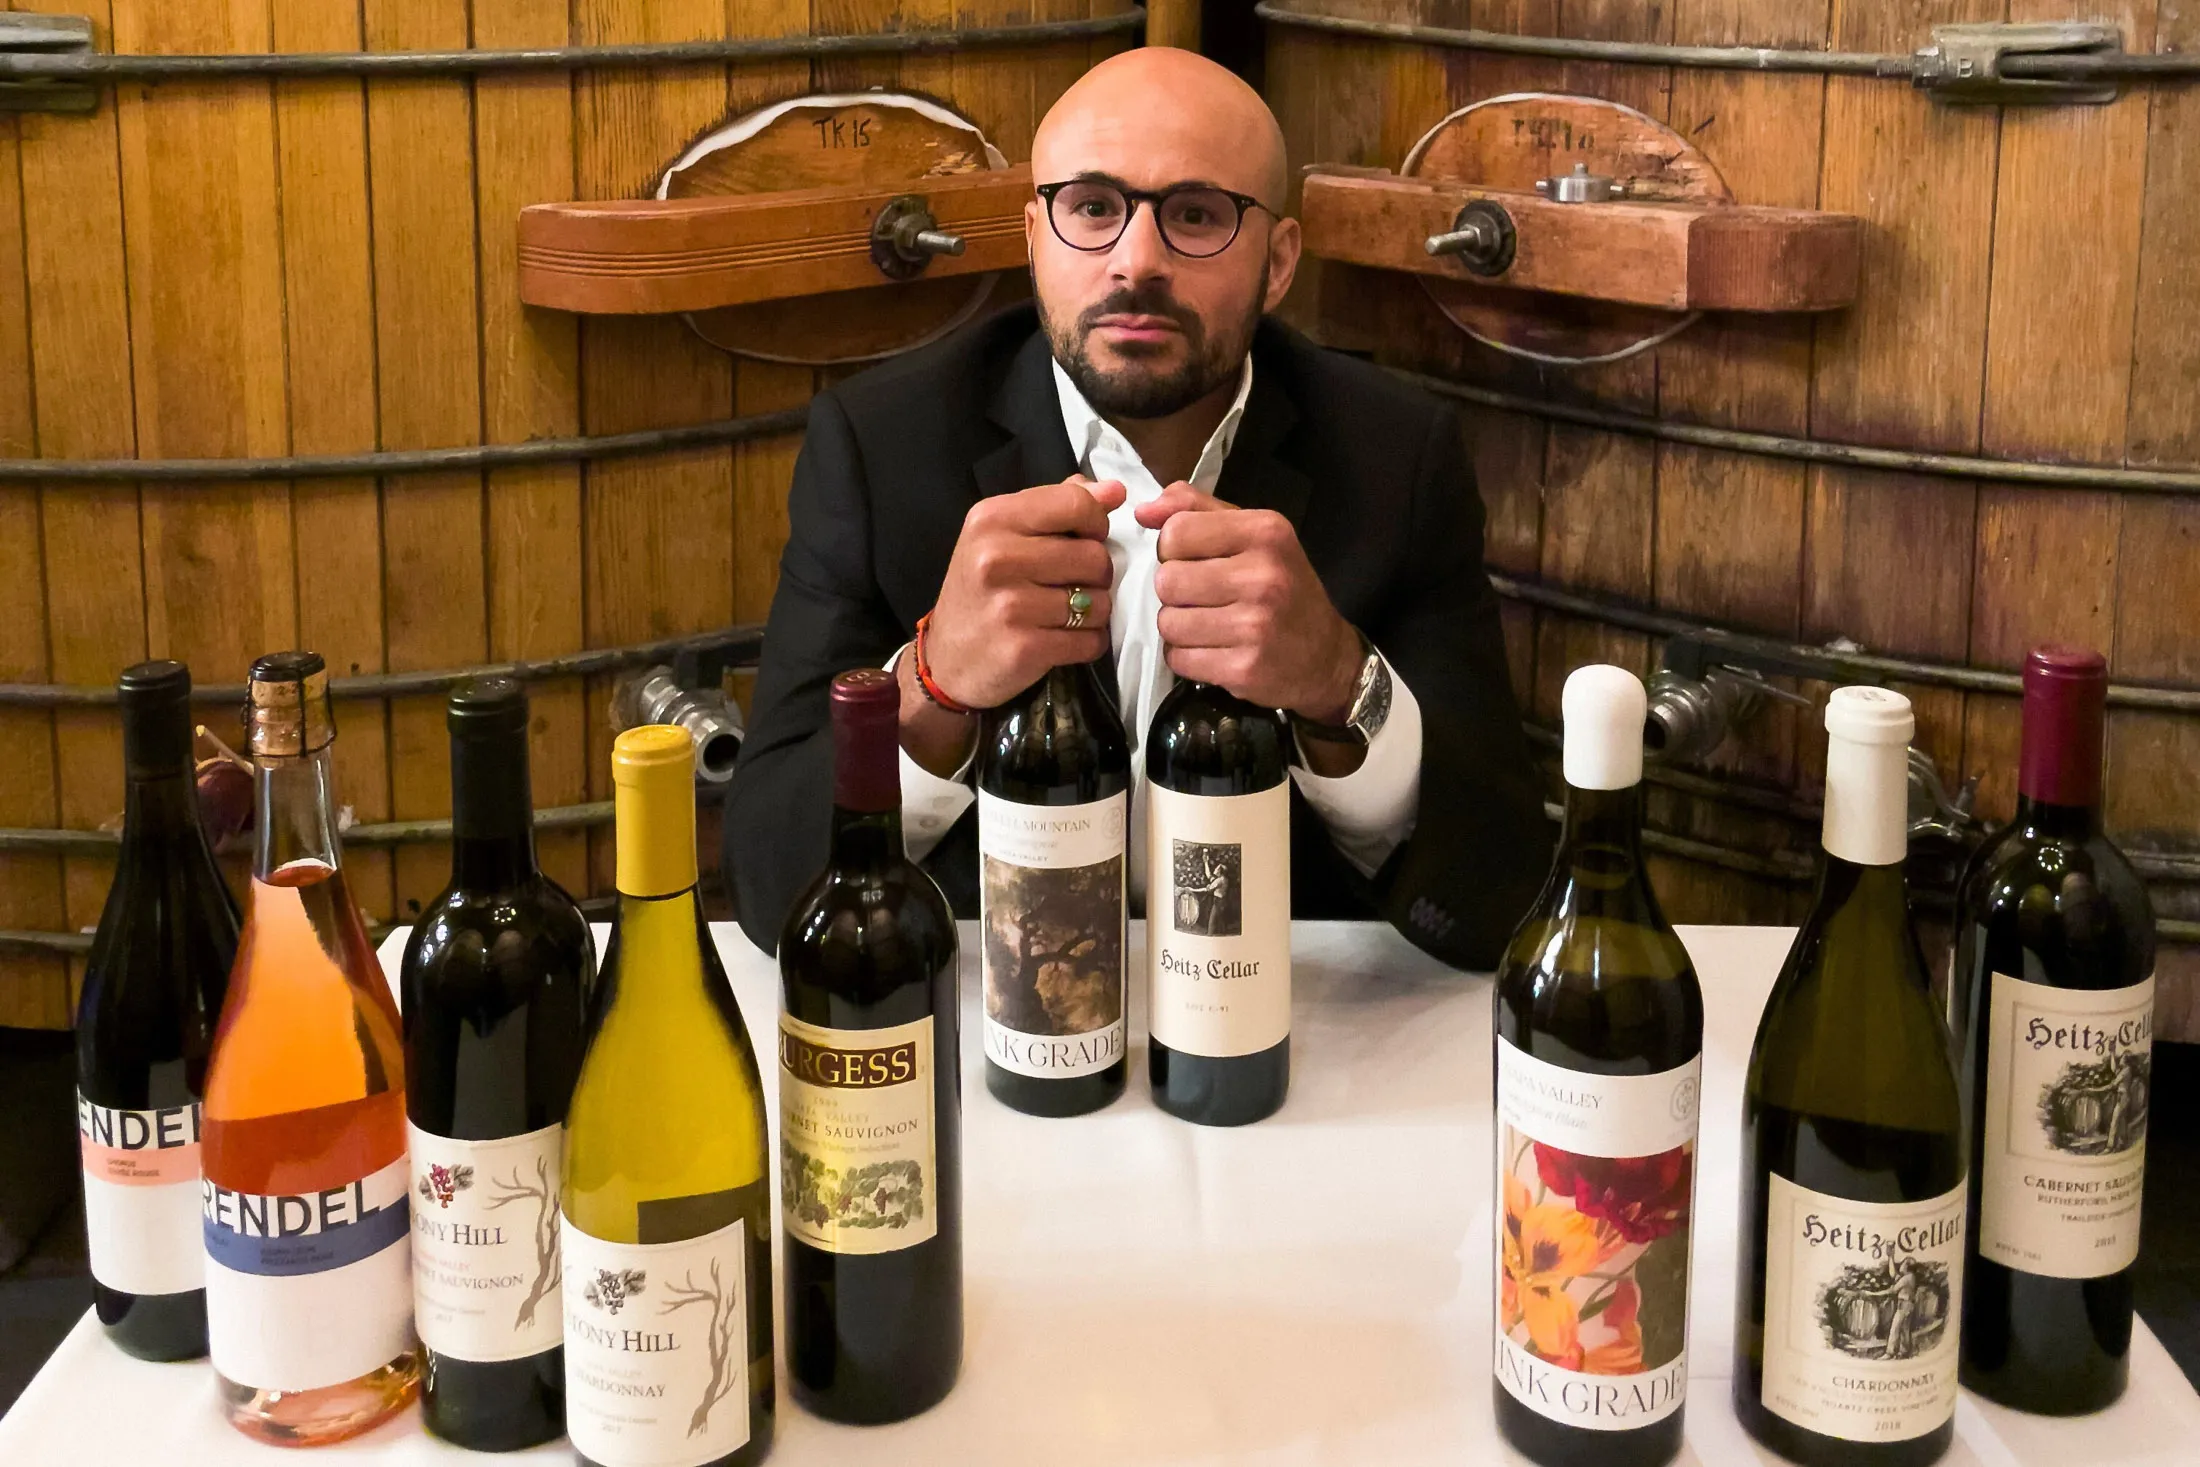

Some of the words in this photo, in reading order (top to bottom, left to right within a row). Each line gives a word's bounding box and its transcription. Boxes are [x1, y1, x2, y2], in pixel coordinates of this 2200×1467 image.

[853, 118, 872, 148] 15
[1023, 818, 1092, 833] MOUNTAIN
[1160, 949, 1202, 981] Heitz
[1206, 959, 1260, 979] Cellar
[1028, 1026, 1123, 1068] GRADE
[2025, 1017, 2107, 1056] Heitz
[825, 1118, 918, 1139] SAUVIGNON
[2024, 1175, 2101, 1193] CABERNET
[1802, 1213, 1885, 1260] Heitz
[1897, 1212, 1962, 1253] Cellar
[1500, 1340, 1549, 1404] INK
[1562, 1361, 1685, 1418] GRADE
[1832, 1373, 1936, 1392] CHARDONNAY
